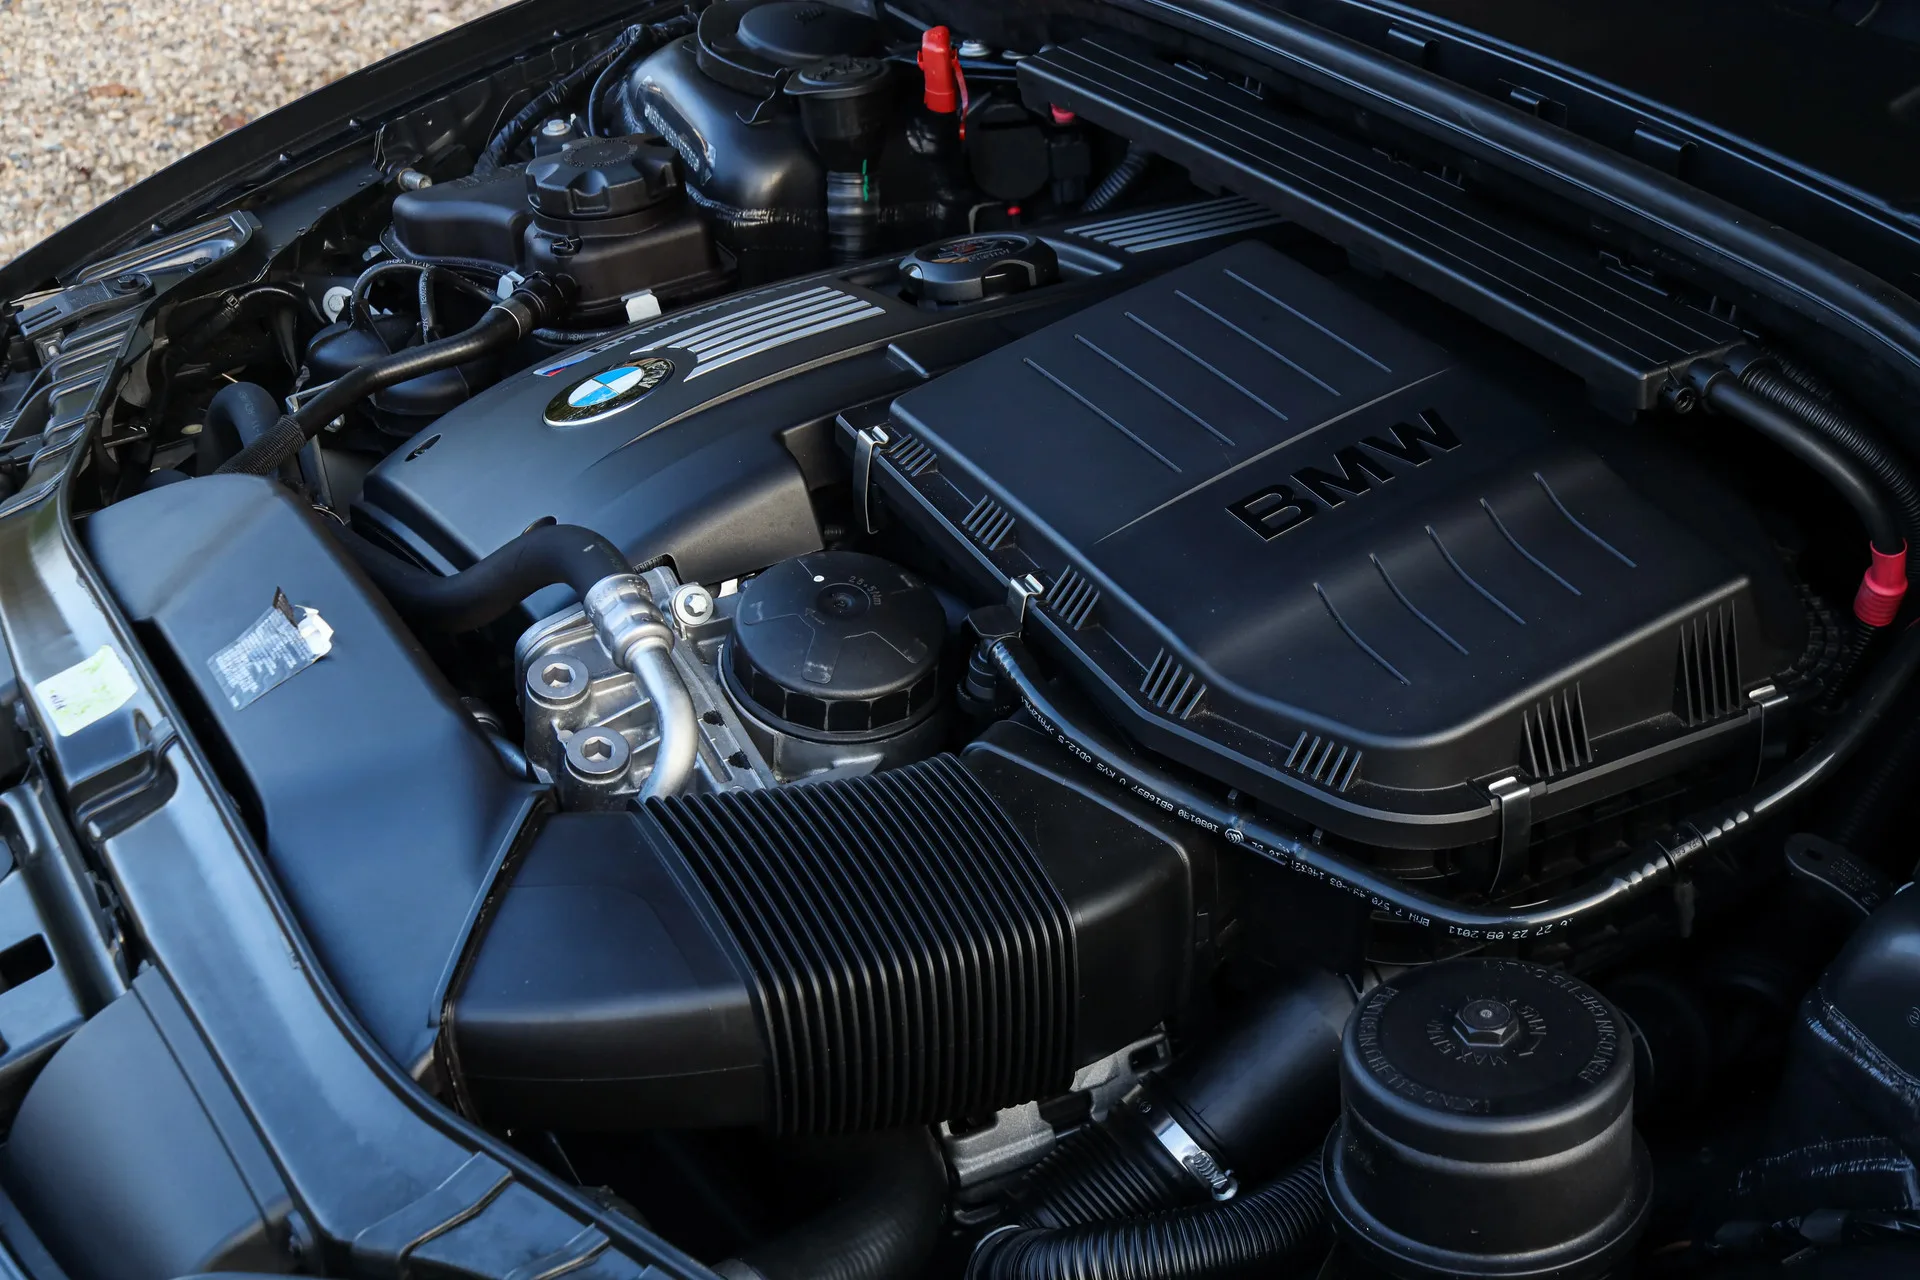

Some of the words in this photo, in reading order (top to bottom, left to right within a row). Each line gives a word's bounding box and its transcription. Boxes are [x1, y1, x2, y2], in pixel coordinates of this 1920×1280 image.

[1225, 408, 1462, 541] BMW
[1096, 762, 1116, 778] KYS
[1449, 925, 1528, 940] 23.08.2011
